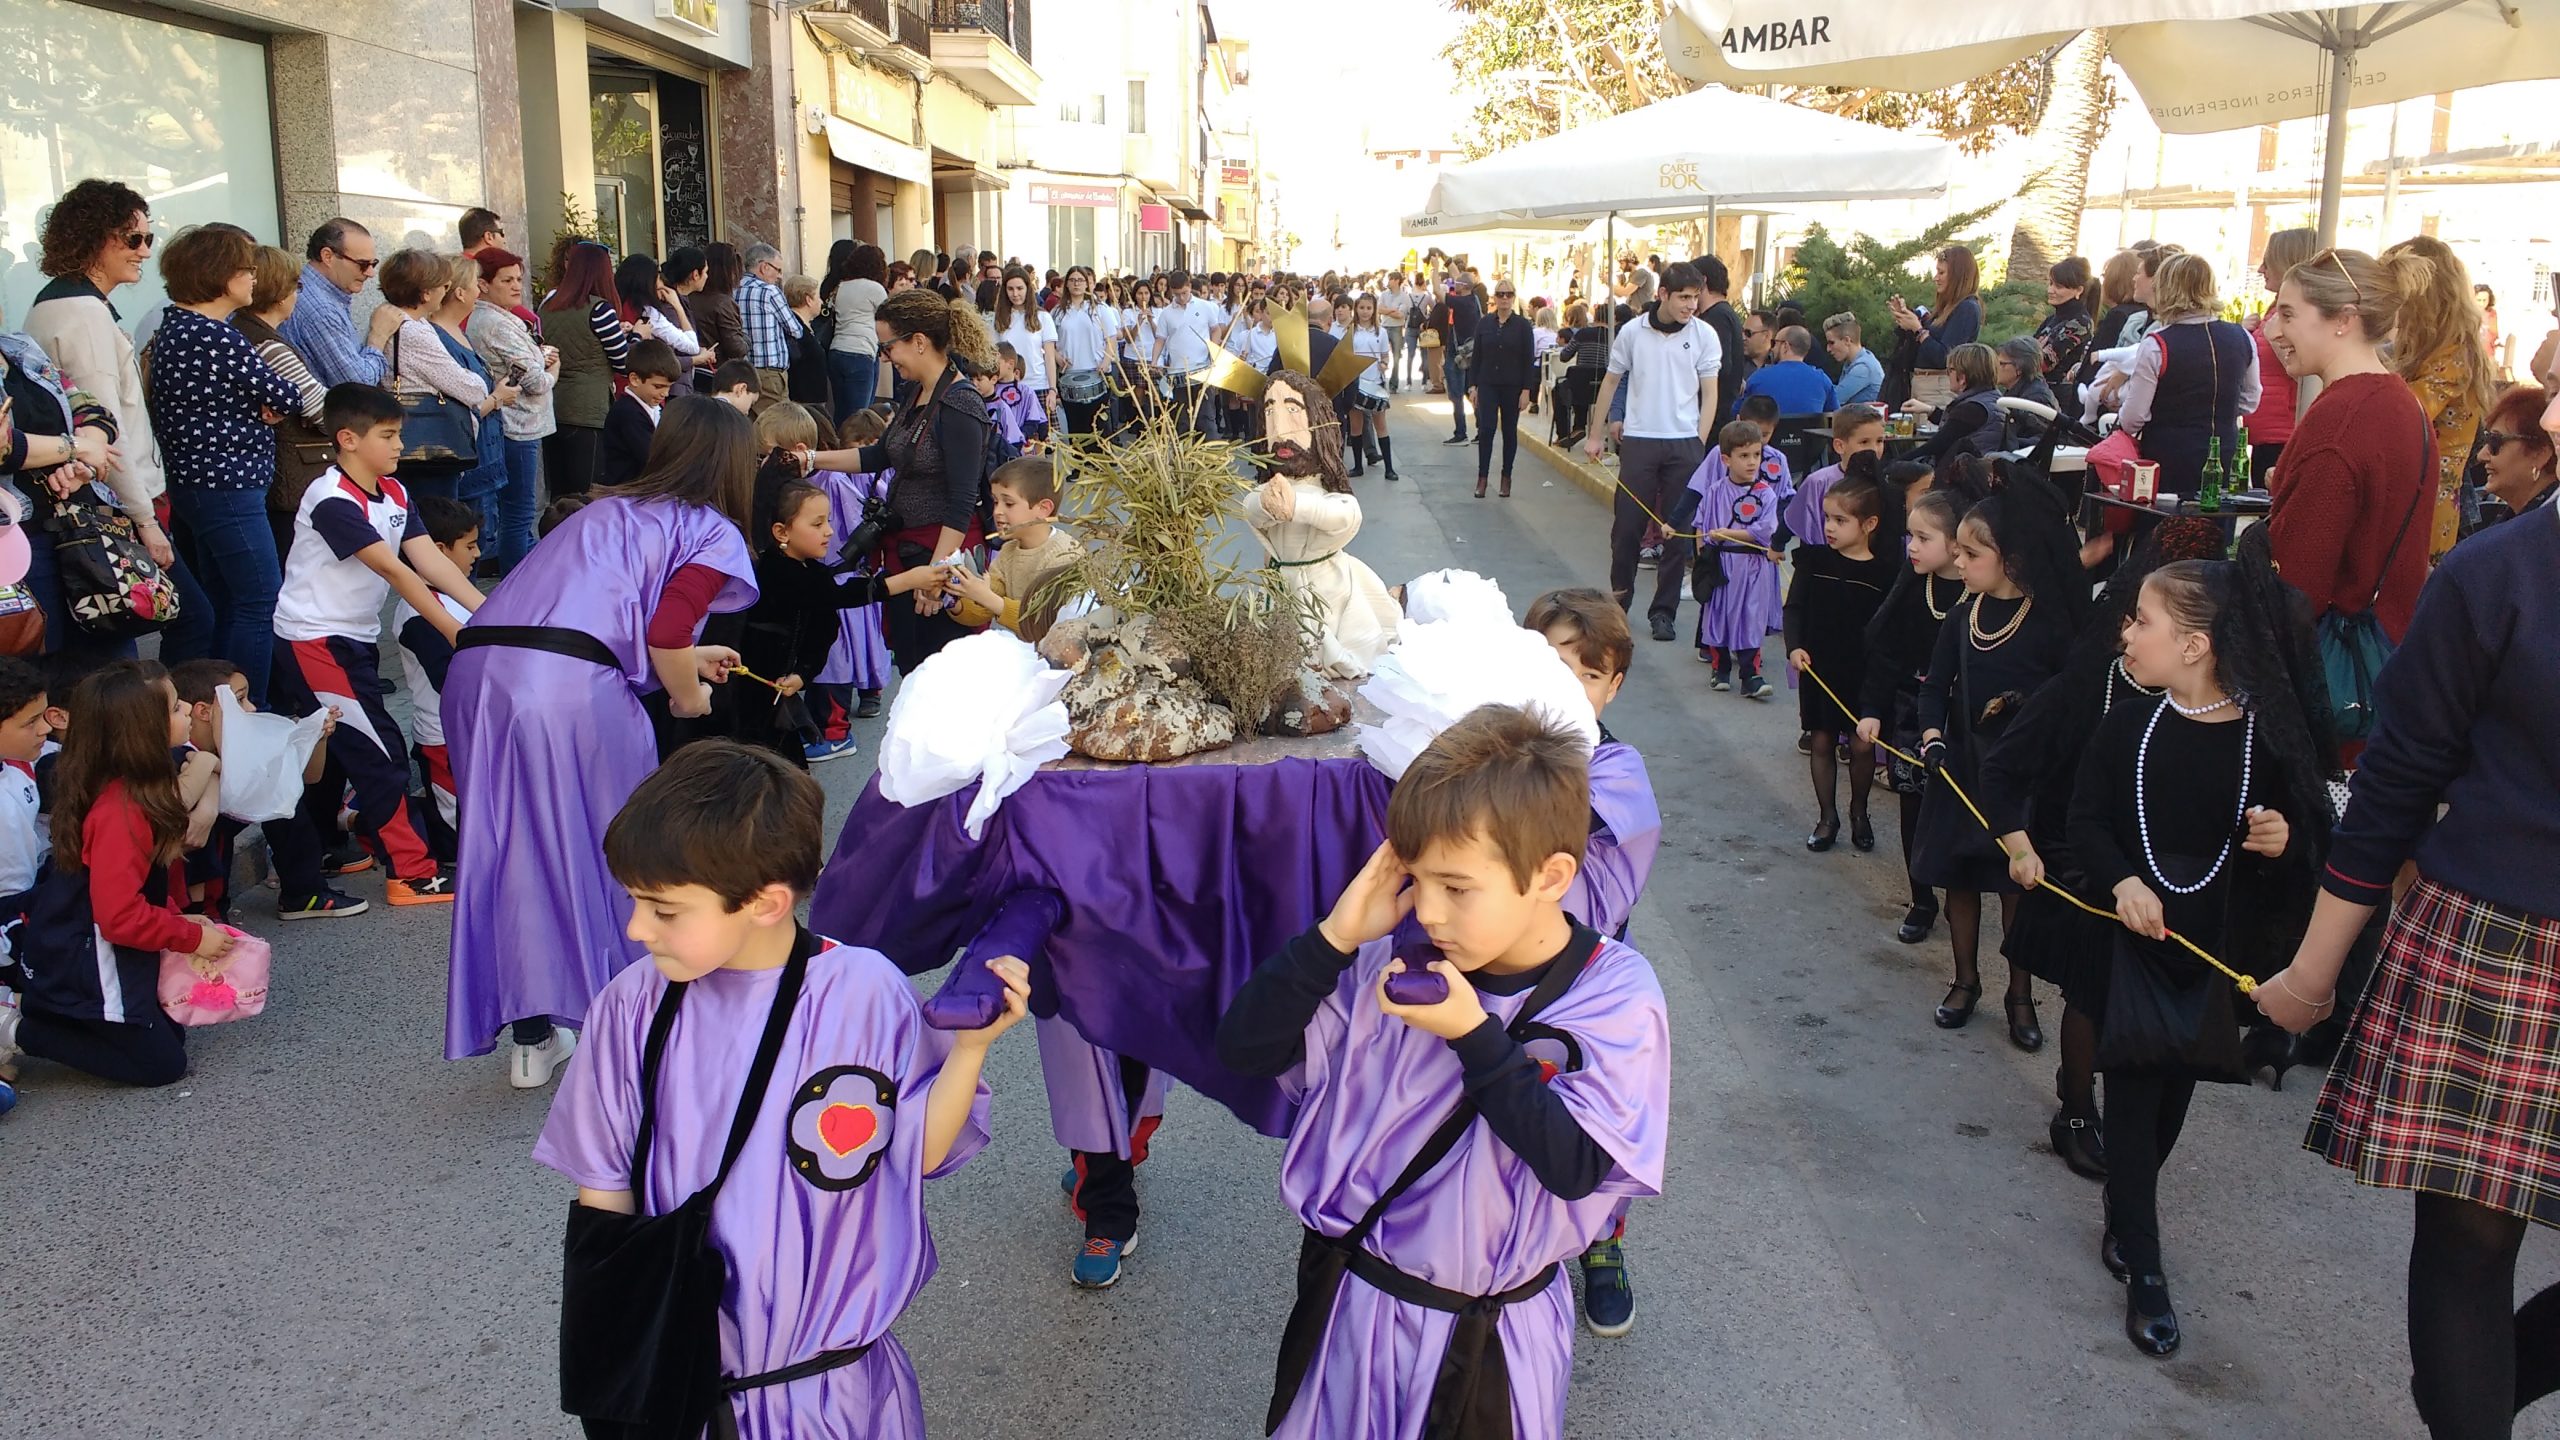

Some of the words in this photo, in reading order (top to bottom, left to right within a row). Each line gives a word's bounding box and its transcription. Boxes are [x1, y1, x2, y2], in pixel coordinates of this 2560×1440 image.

[1721, 15, 1831, 54] AMBAR
[1660, 163, 1699, 175] CARTE
[1411, 216, 1438, 229] AMBAR
